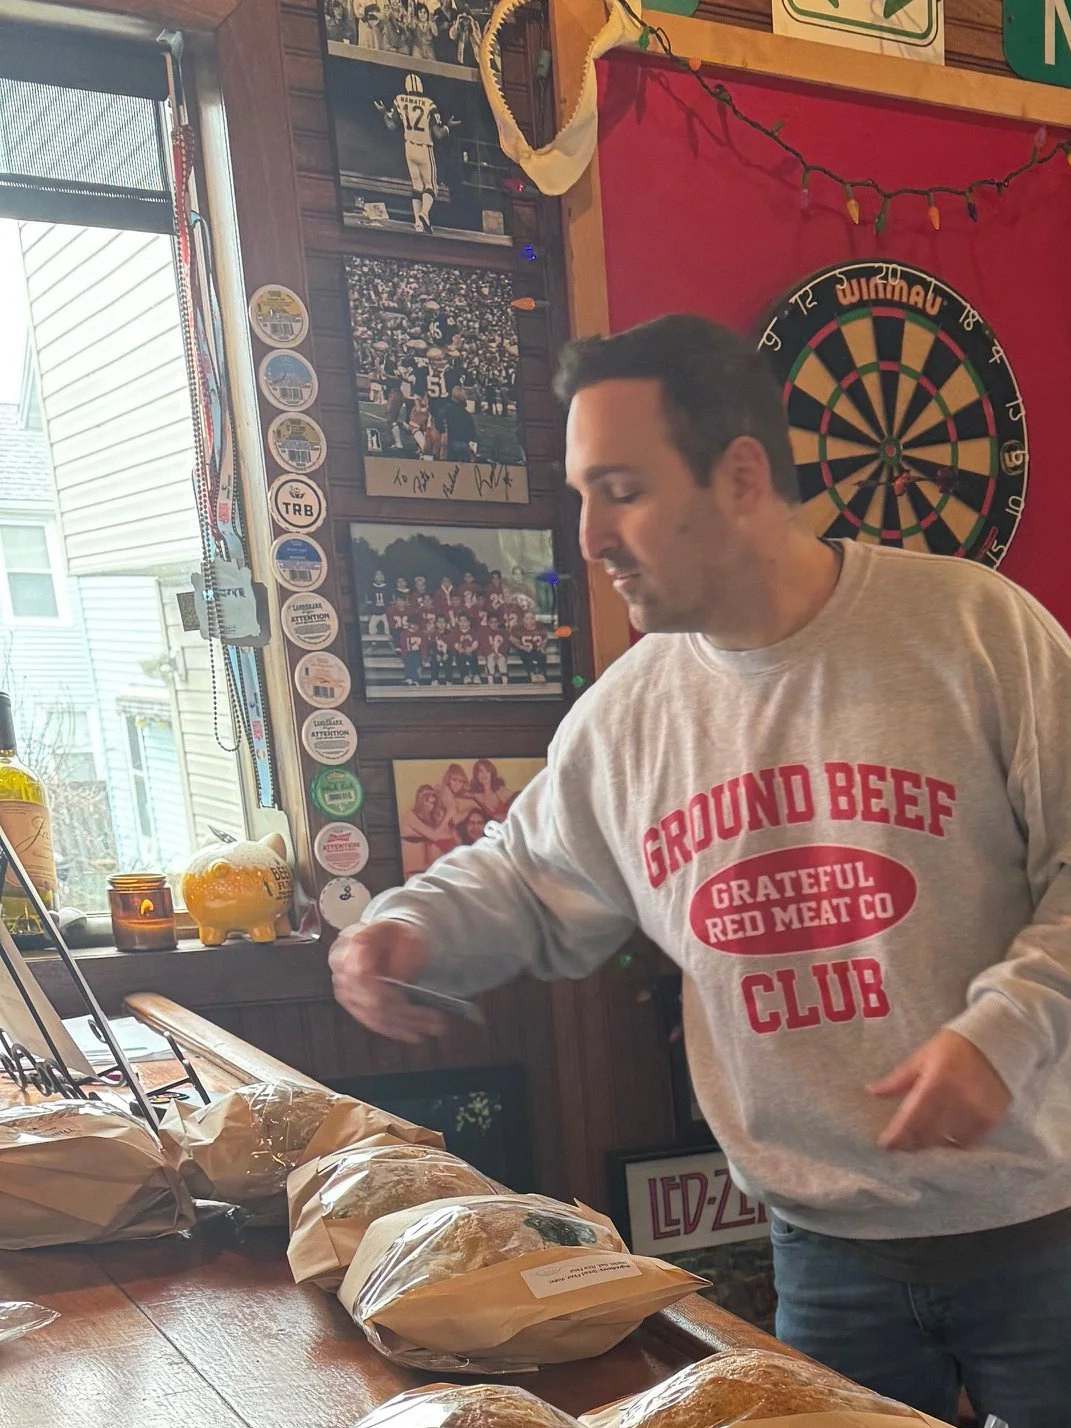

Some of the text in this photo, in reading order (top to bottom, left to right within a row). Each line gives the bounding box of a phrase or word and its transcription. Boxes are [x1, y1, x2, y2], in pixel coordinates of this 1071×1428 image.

[403, 104, 425, 132] 12
[876, 262, 902, 286] 20
[427, 376, 449, 398] 51
[282, 502, 314, 517] TRB
[291, 613, 330, 624] ATTENTION
[311, 730, 350, 738] ATTENTION
[643, 762, 957, 889] GROUND BEEF
[711, 861, 874, 910] GRATEFUL
[705, 892, 895, 944] RED MEAT CO
[740, 957, 892, 1034] CLUB
